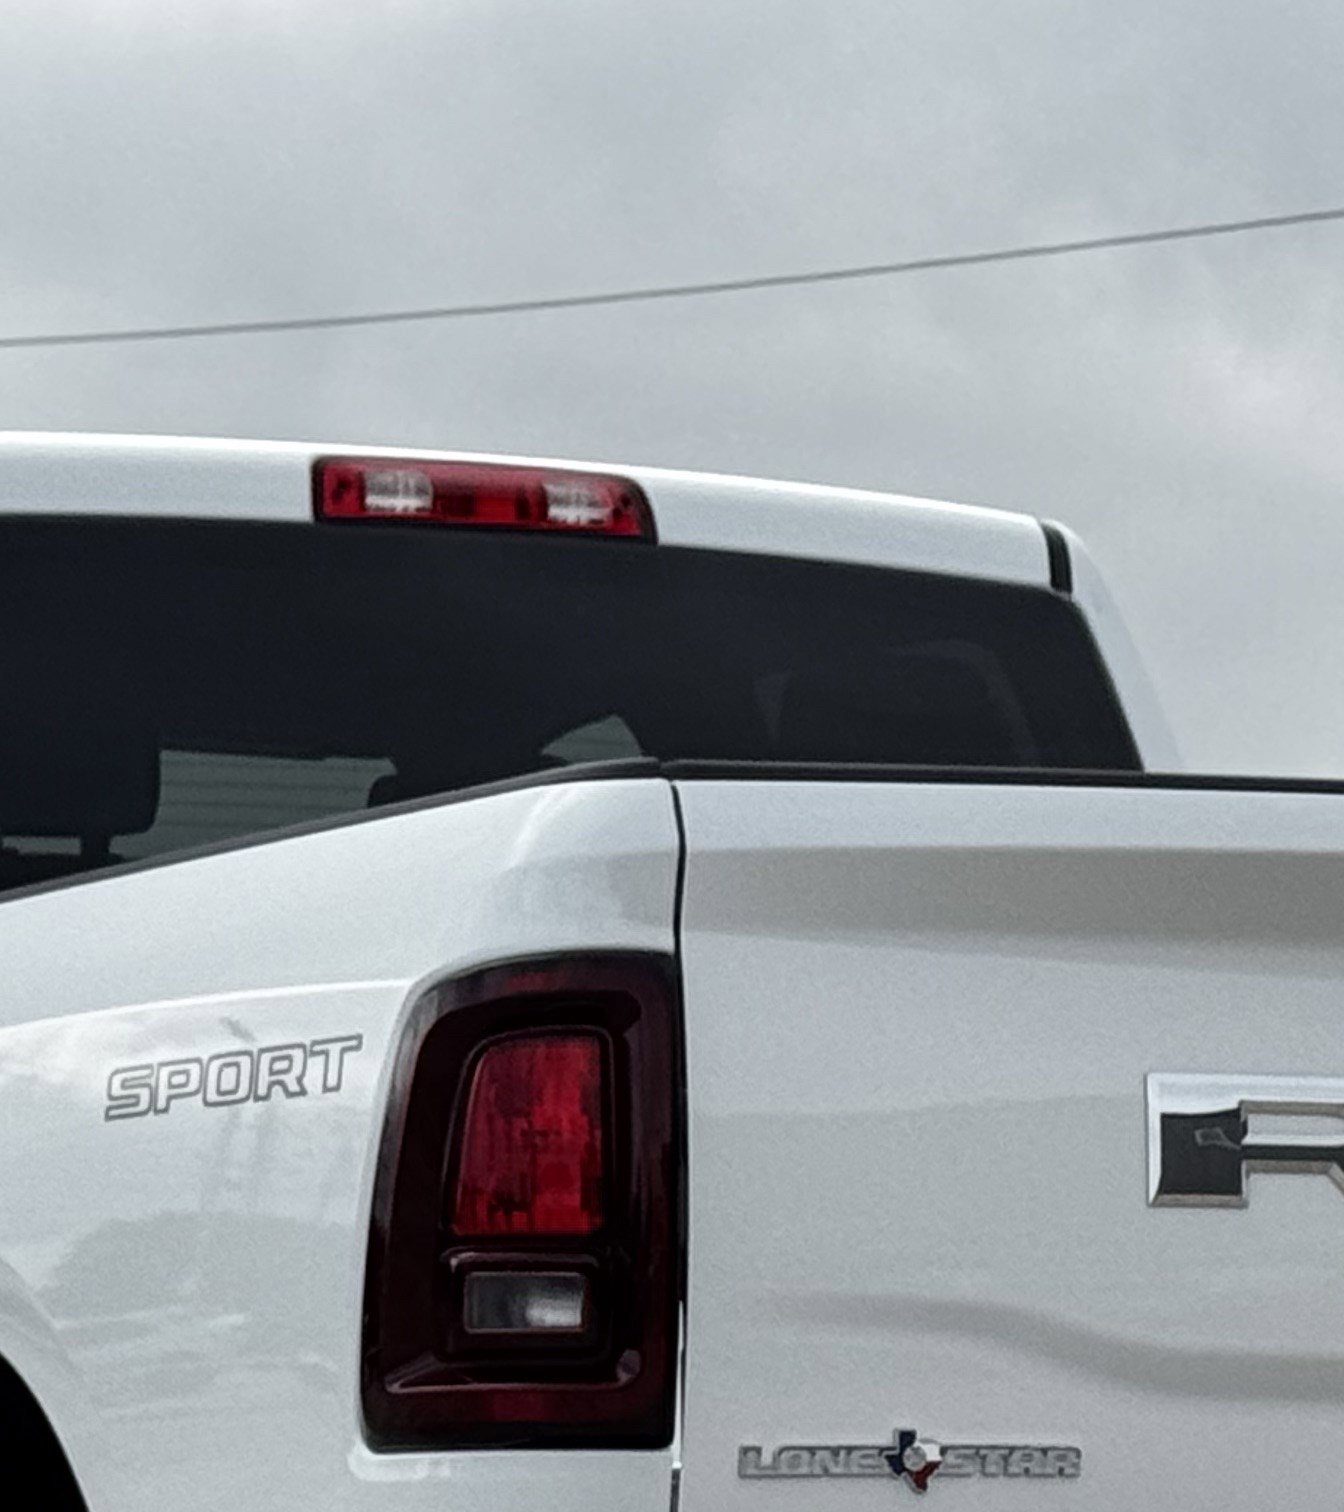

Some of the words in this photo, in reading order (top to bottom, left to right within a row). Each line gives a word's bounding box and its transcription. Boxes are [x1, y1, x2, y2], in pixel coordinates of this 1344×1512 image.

[104, 1033, 363, 1121] SPORT
[738, 1445, 899, 1479] LONE
[939, 1444, 1082, 1478] STAR
